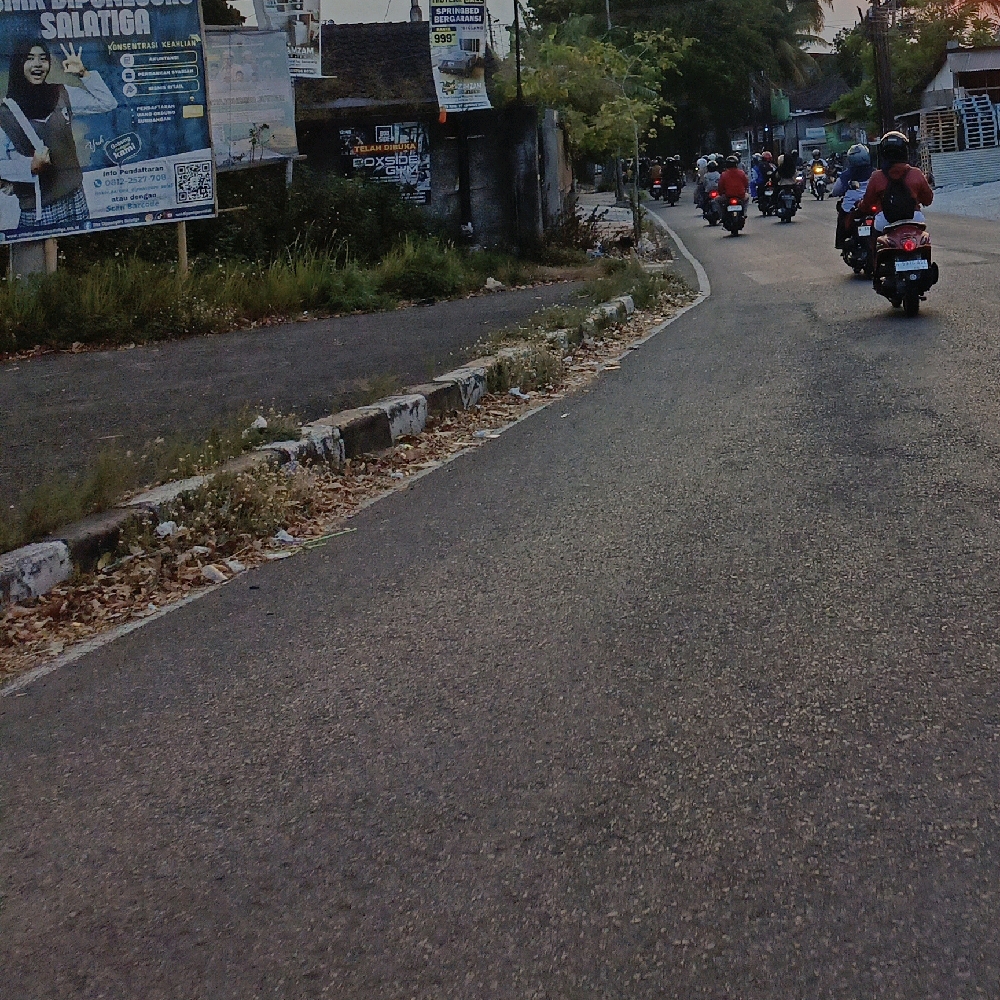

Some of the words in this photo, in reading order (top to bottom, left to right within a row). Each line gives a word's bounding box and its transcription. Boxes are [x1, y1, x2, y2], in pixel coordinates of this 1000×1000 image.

[436, 7, 480, 16] SPRINGBED
[40, 8, 151, 40] SALATIGA
[434, 15, 482, 24] BERGARANSI
[434, 33, 454, 44] 999
[108, 41, 158, 54] KONSENTRASI
[161, 40, 196, 49] KEAHLIAN
[113, 143, 136, 160] kami
[354, 145, 382, 153] TELAH
[384, 143, 416, 151] DIBUKA
[119, 165, 164, 175] Pendaftaran
[386, 165, 418, 176] GYM
[111, 195, 129, 203] atau
[129, 192, 157, 202] dengan
[127, 200, 160, 210] Barcode
